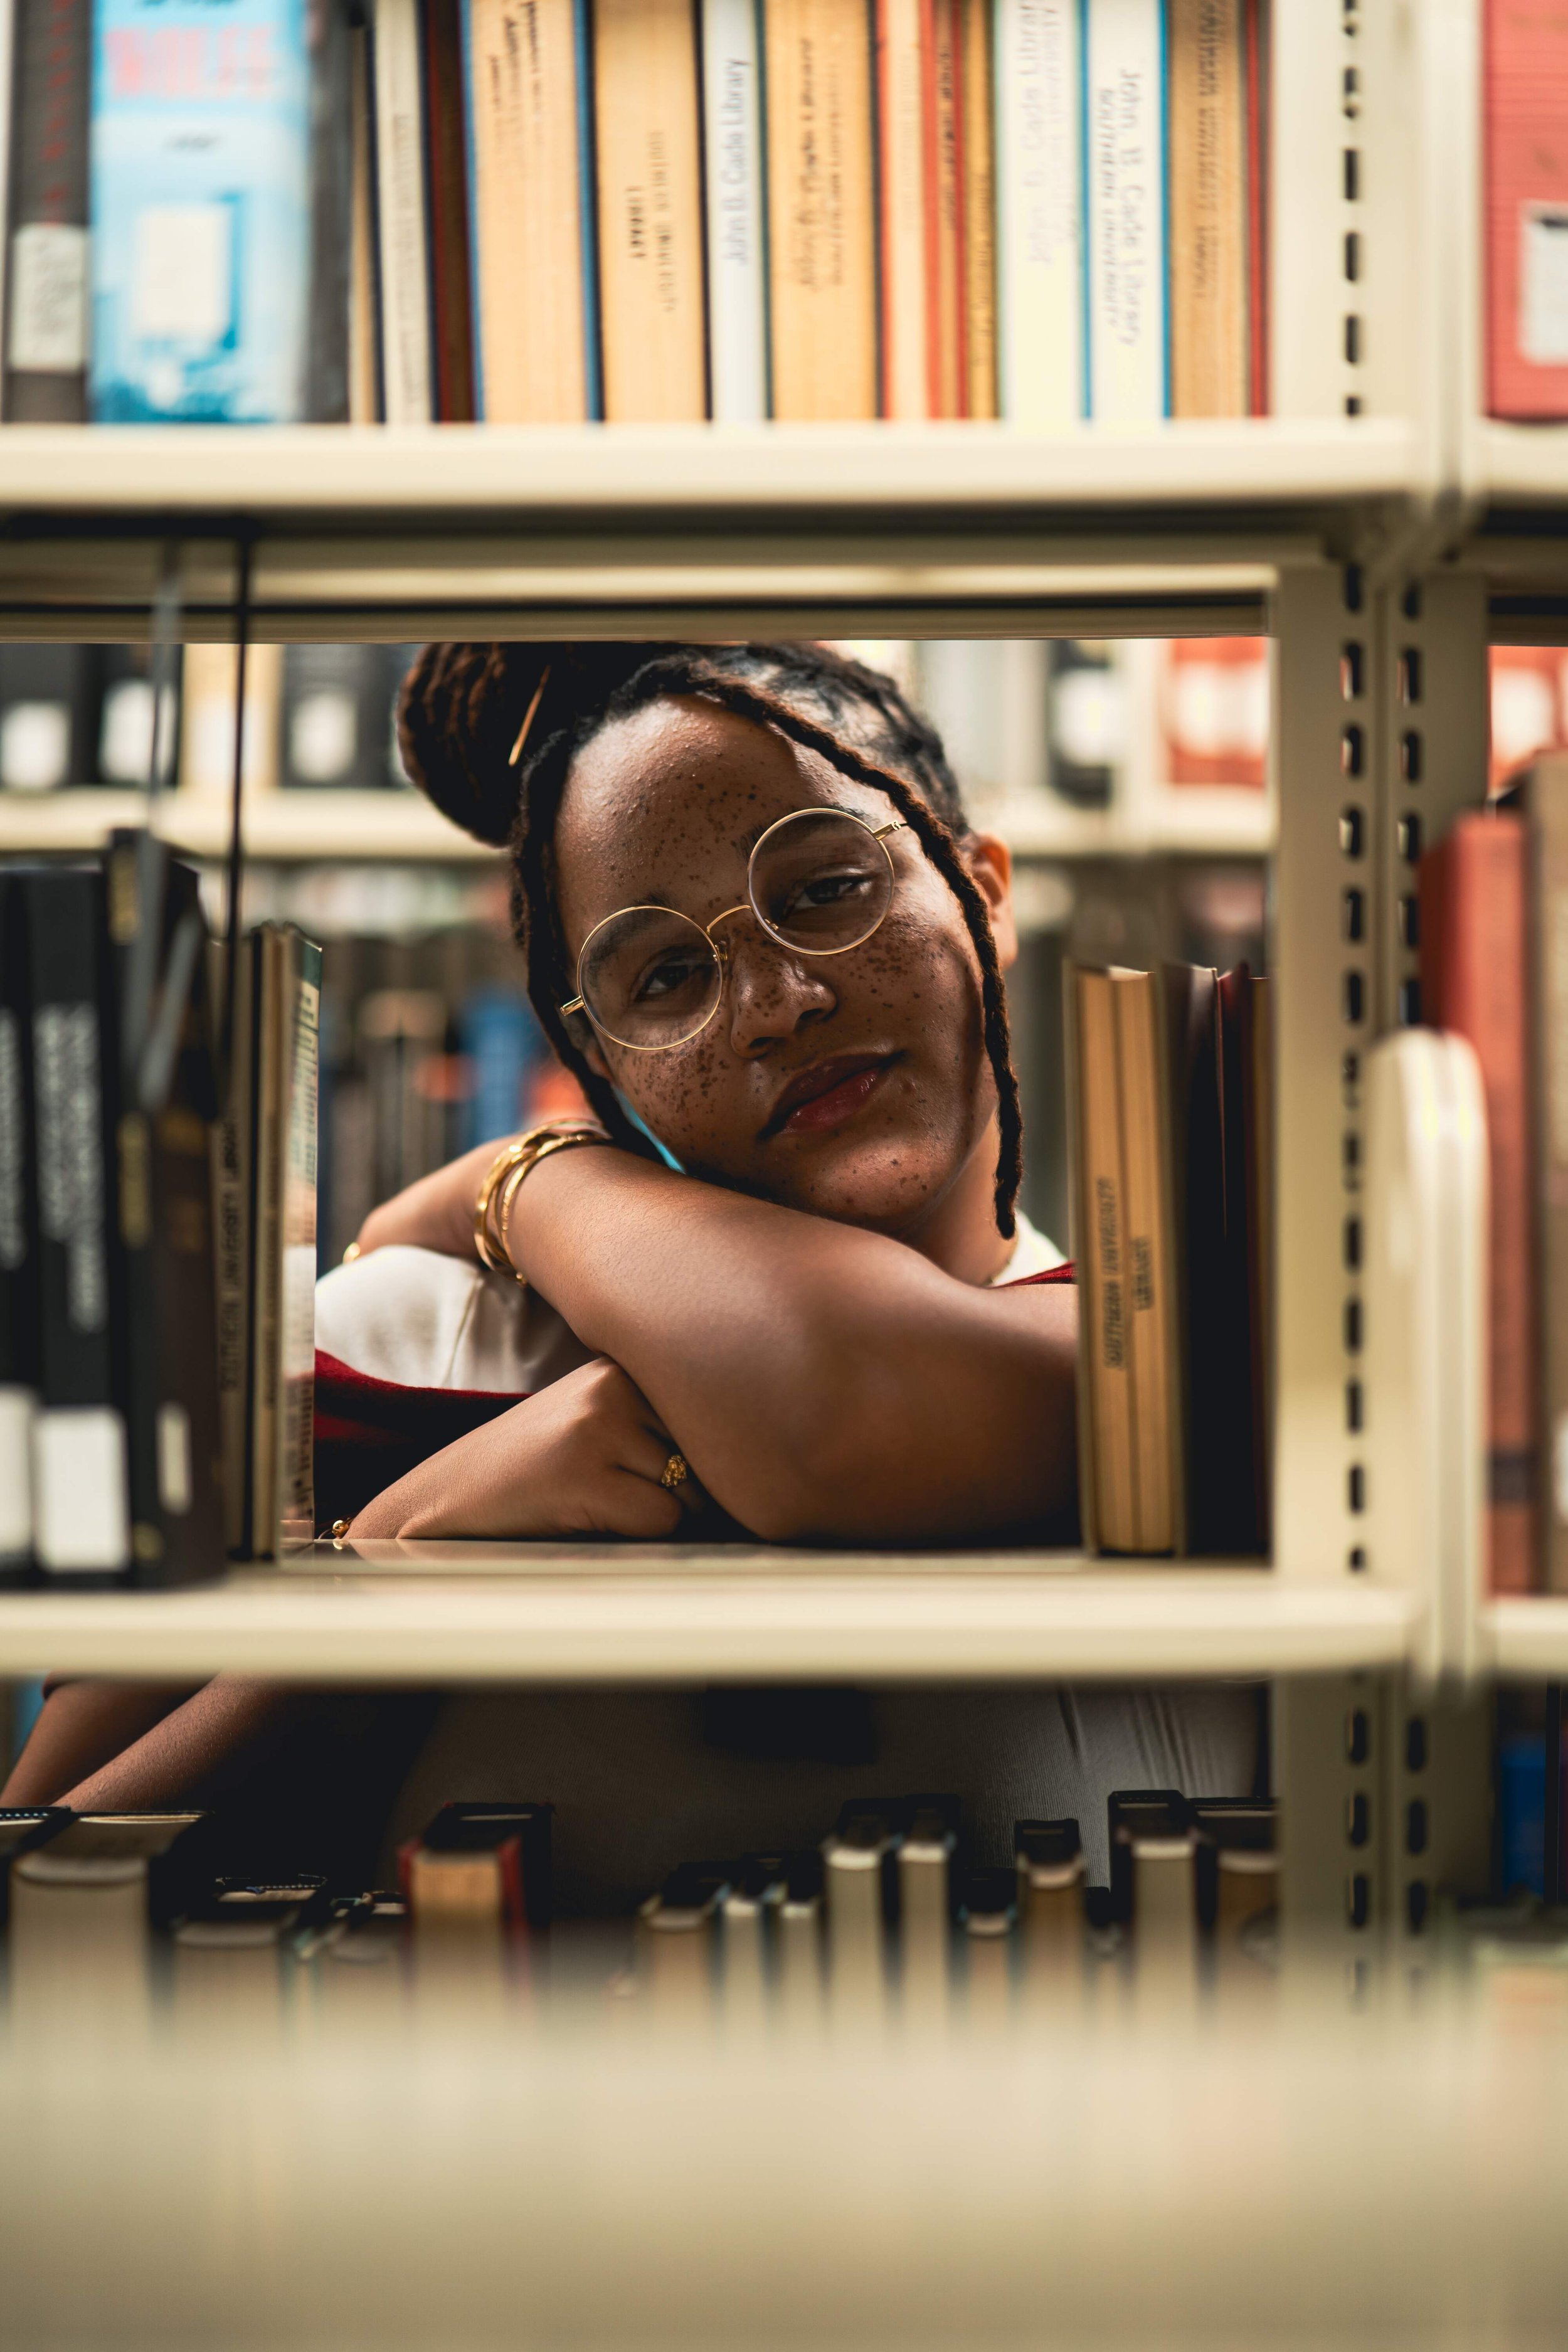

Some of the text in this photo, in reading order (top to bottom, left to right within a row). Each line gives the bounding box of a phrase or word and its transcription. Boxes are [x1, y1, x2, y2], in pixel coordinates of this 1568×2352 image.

[718, 58, 750, 126] Library
[1118, 68, 1145, 129] John
[1118, 184, 1145, 248] Cade
[1116, 258, 1146, 347] Library
